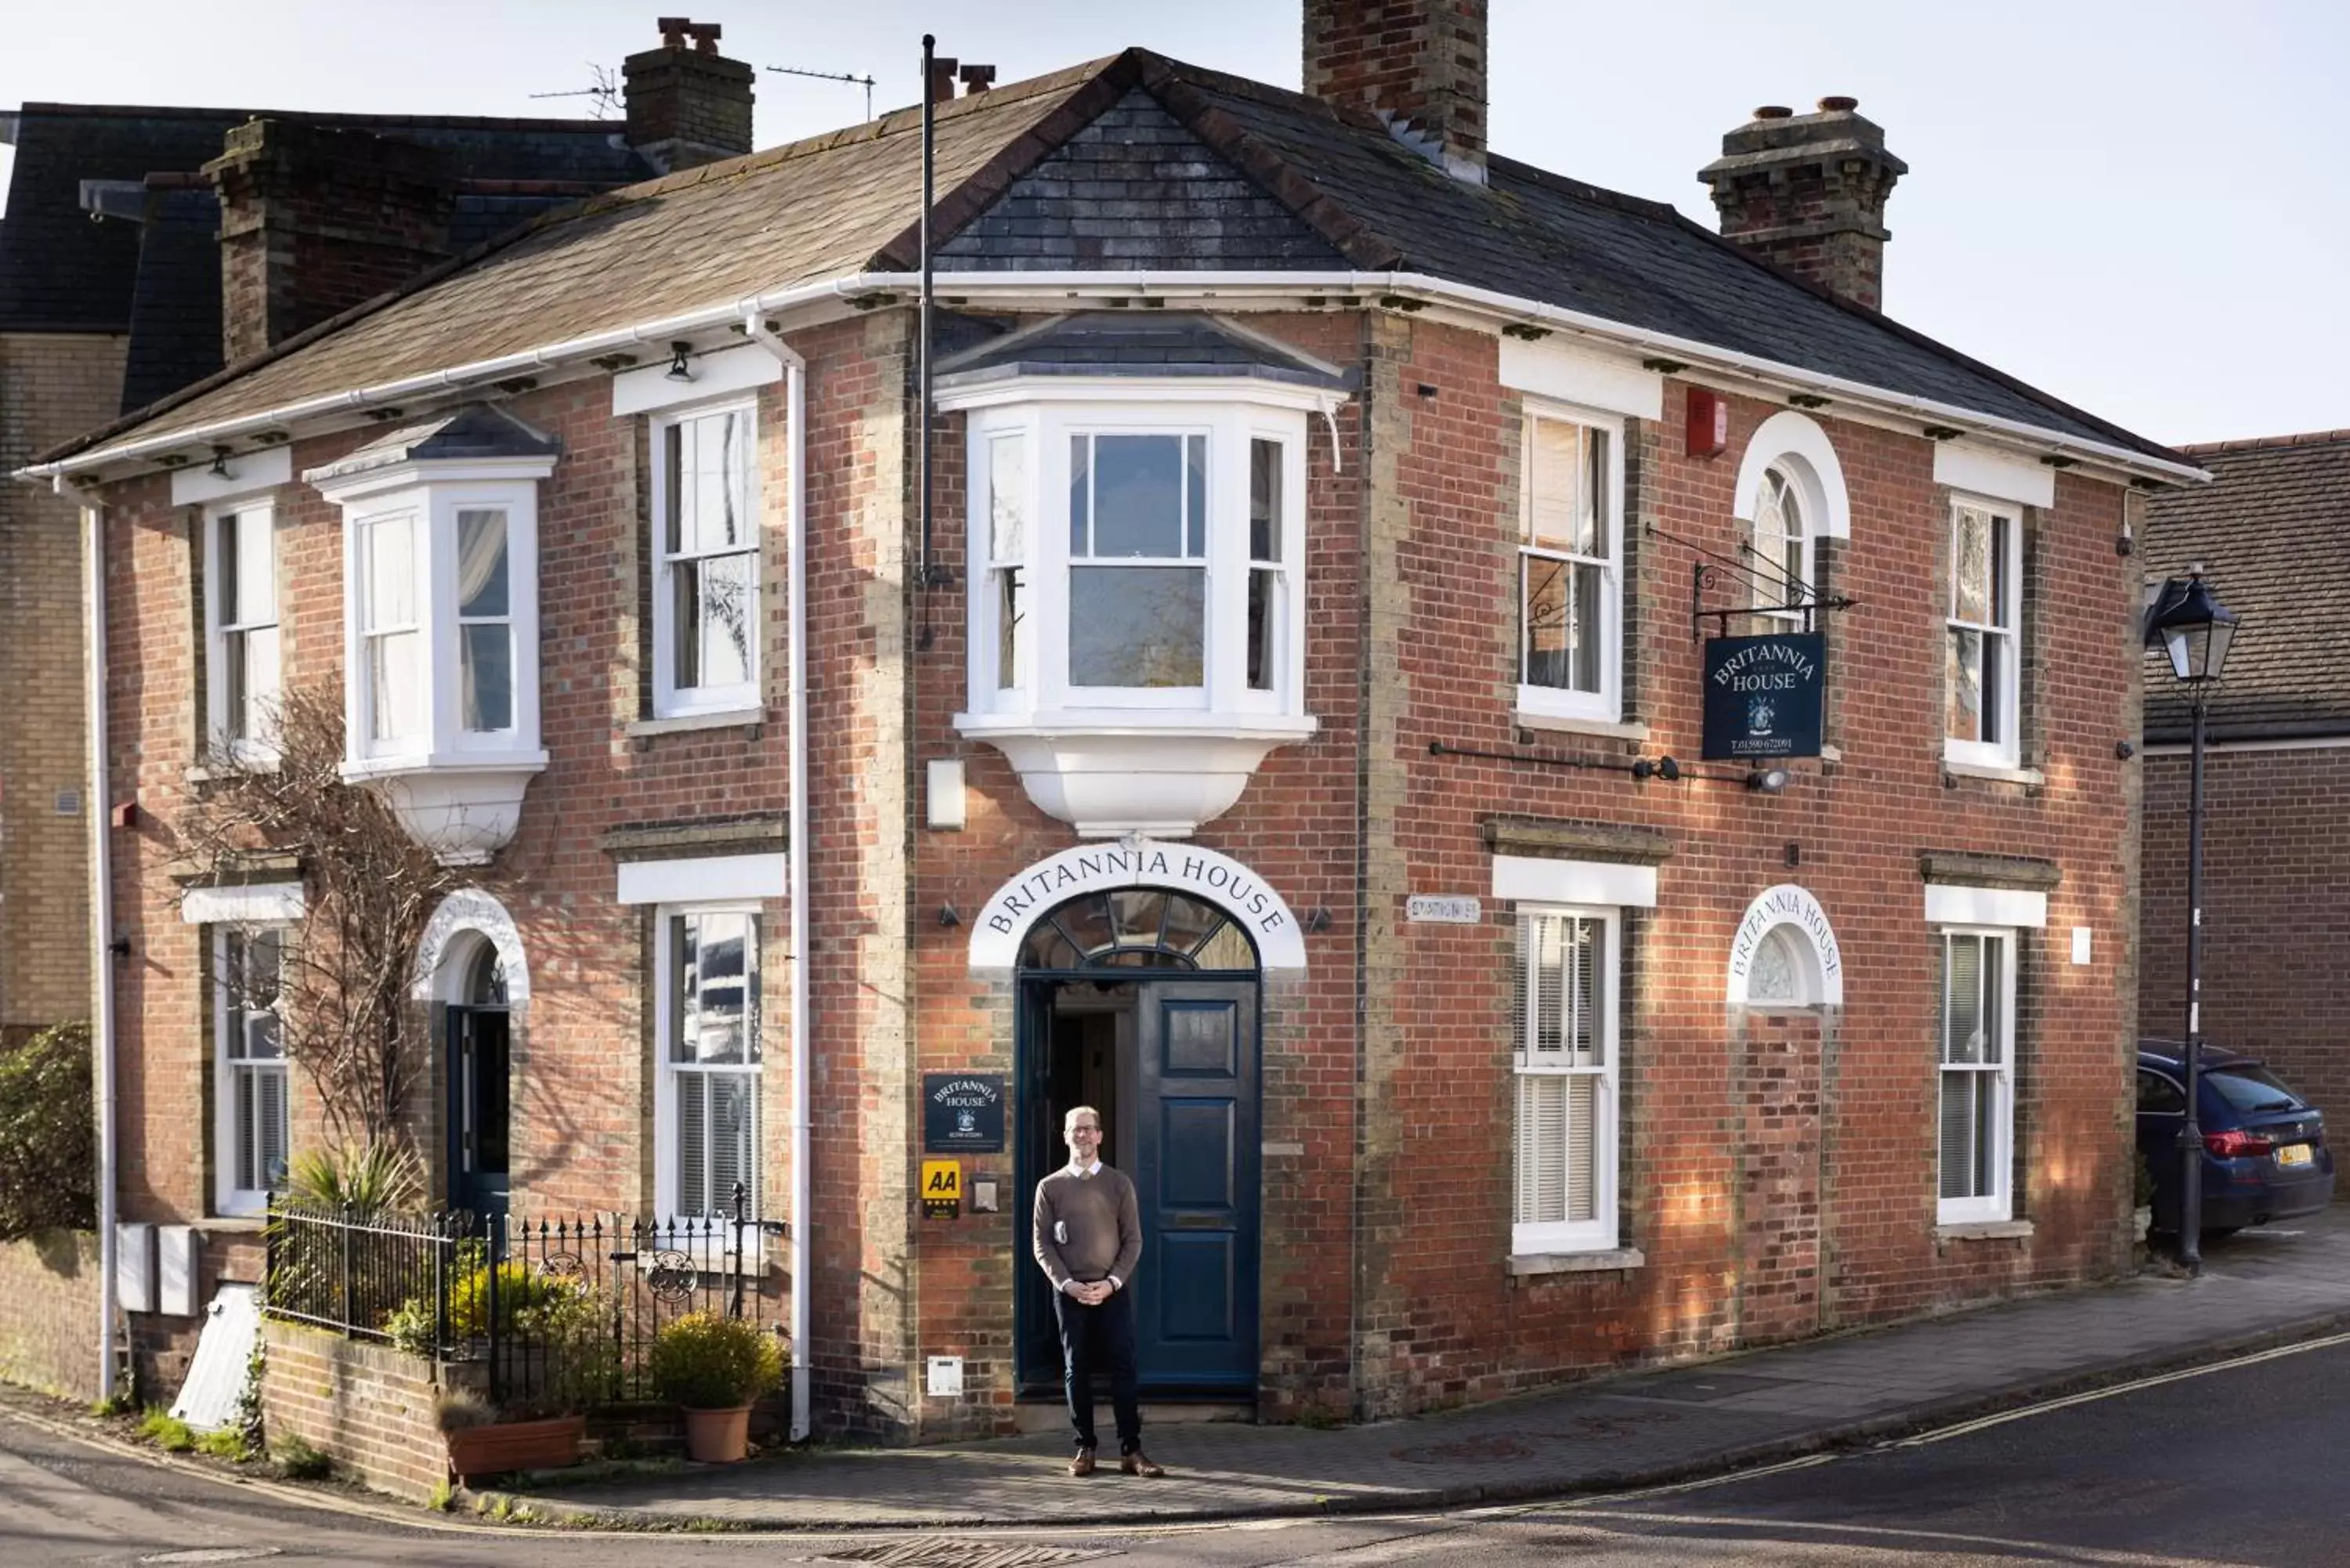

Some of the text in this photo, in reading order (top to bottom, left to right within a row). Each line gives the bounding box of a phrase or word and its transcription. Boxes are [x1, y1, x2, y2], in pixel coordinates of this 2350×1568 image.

[1714, 645, 1814, 685] BRITANNIA
[1733, 673, 1796, 692] HOUSE
[989, 850, 1285, 935] BRITANNIA HOUSE
[1804, 902, 1837, 979] HOUSE
[934, 1080, 997, 1104] BRITANNIA
[946, 1096, 987, 1107] HOUSE
[928, 1171, 956, 1191] AA
